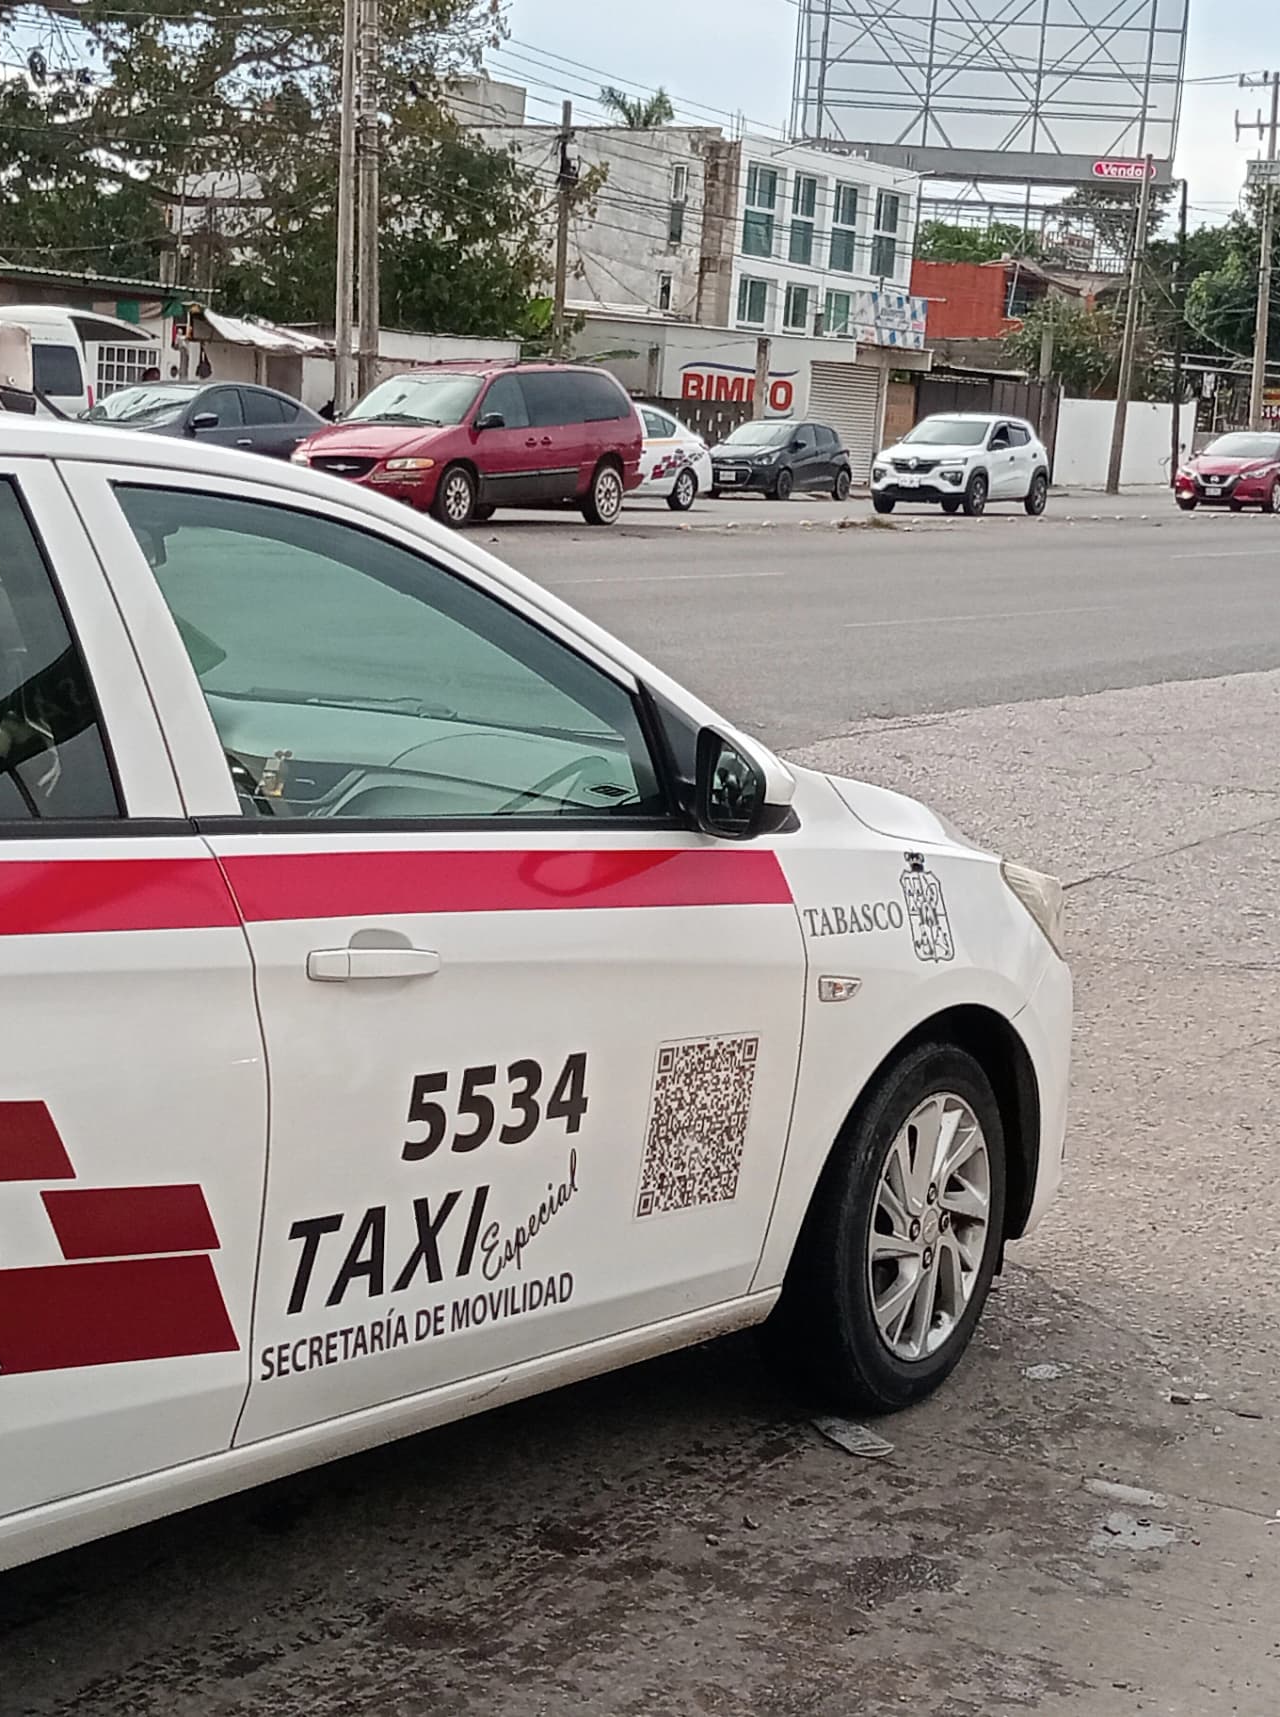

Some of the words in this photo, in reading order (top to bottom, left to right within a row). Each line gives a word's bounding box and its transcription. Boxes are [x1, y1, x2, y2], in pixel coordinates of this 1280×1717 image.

[803, 901, 903, 937] TABASCO
[400, 1051, 588, 1162] 5534
[286, 1184, 490, 1315] TAXI
[480, 1148, 578, 1281] Especial
[261, 1307, 409, 1381] SECRETARÍA
[414, 1304, 446, 1342] DE
[450, 1272, 574, 1333] MOVILIDAD
